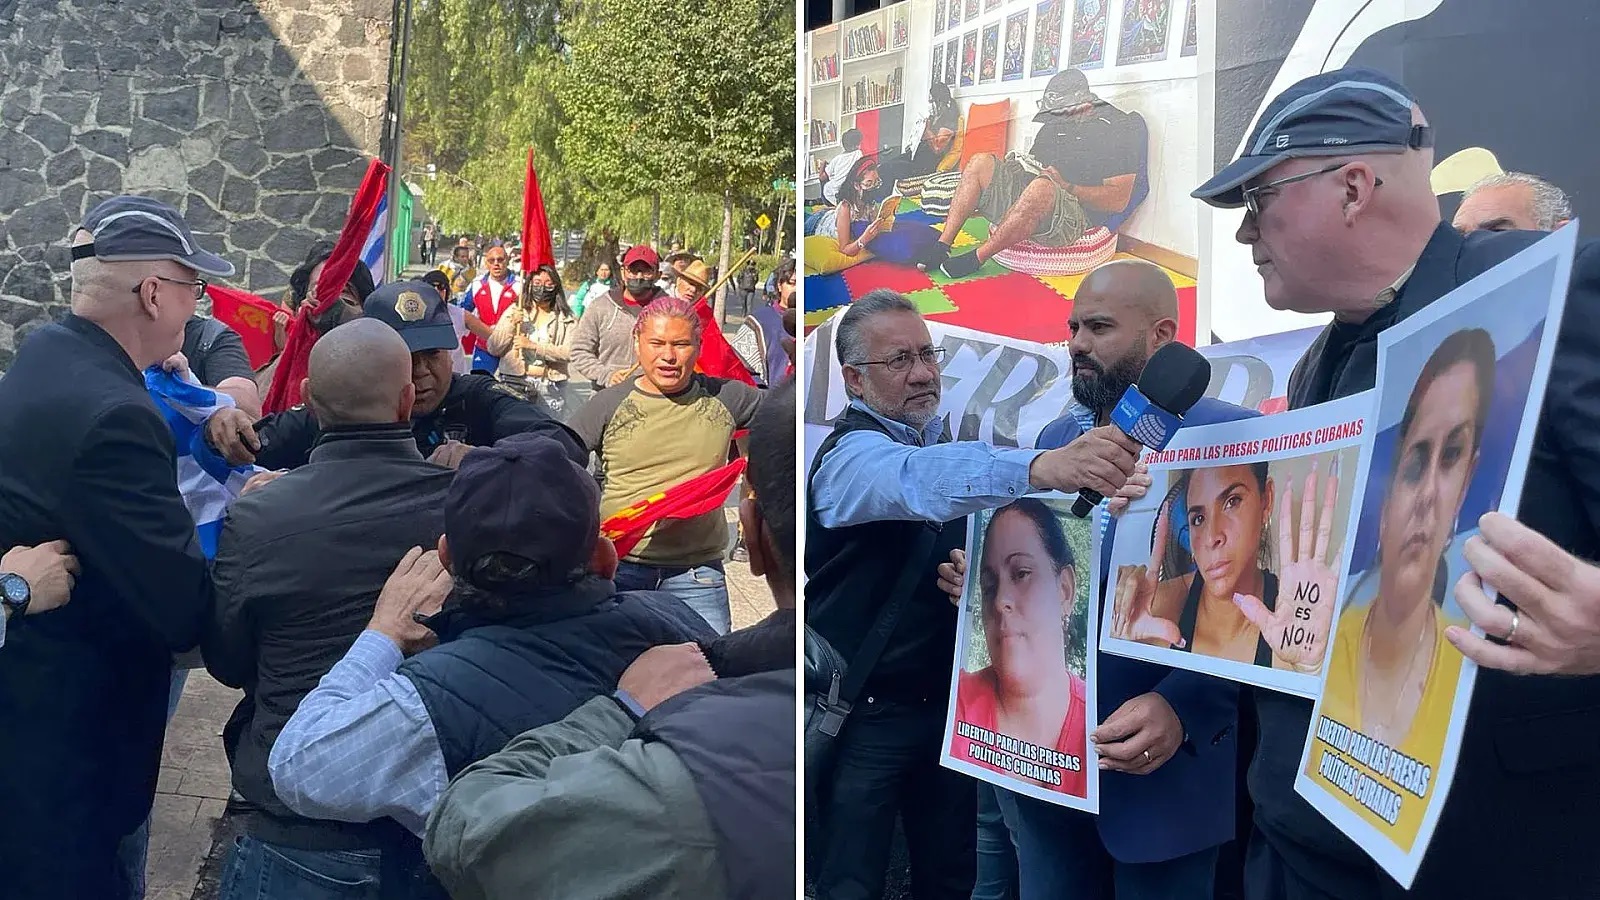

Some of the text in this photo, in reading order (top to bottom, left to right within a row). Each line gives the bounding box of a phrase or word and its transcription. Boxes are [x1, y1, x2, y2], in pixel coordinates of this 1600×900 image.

[1144, 419, 1364, 464] BERTAD PARA LAS PRESAS POLÍTICAS CUBANAS
[1294, 581, 1320, 604] NO
[1295, 607, 1311, 621] ES
[1280, 624, 1315, 651] NO!!
[957, 721, 1081, 771] LIBERTAD PARA LAS PRESAS
[969, 743, 1062, 785] POLÍTICAS CUBANAS
[1316, 715, 1431, 799] LIBERTAD PARA LAS PRESAS
[1319, 749, 1402, 826] POLÍTICAS CUBANAS
